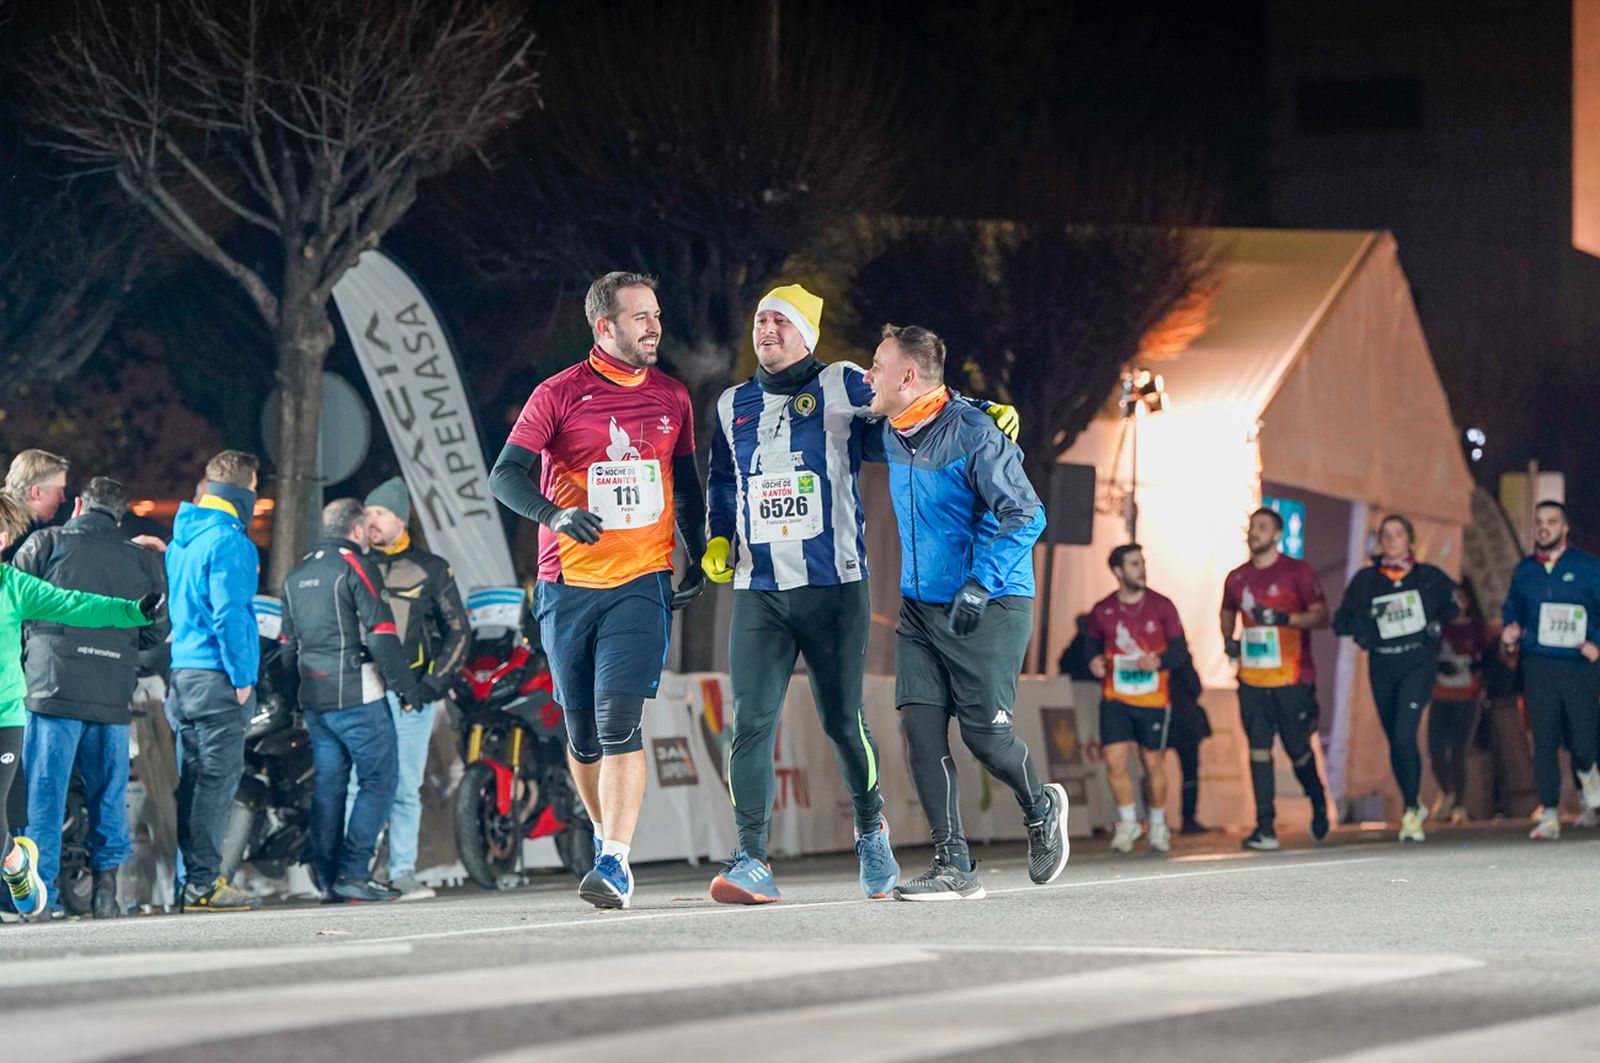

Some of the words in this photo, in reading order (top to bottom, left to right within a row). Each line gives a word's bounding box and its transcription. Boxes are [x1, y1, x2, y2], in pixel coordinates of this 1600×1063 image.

[395, 302, 492, 522] JAPEMASA
[604, 468, 626, 476] NOCHE
[596, 478, 611, 486] SAN
[613, 486, 640, 506] 111
[768, 487, 792, 497] ANTÓN
[760, 496, 808, 519] 6526
